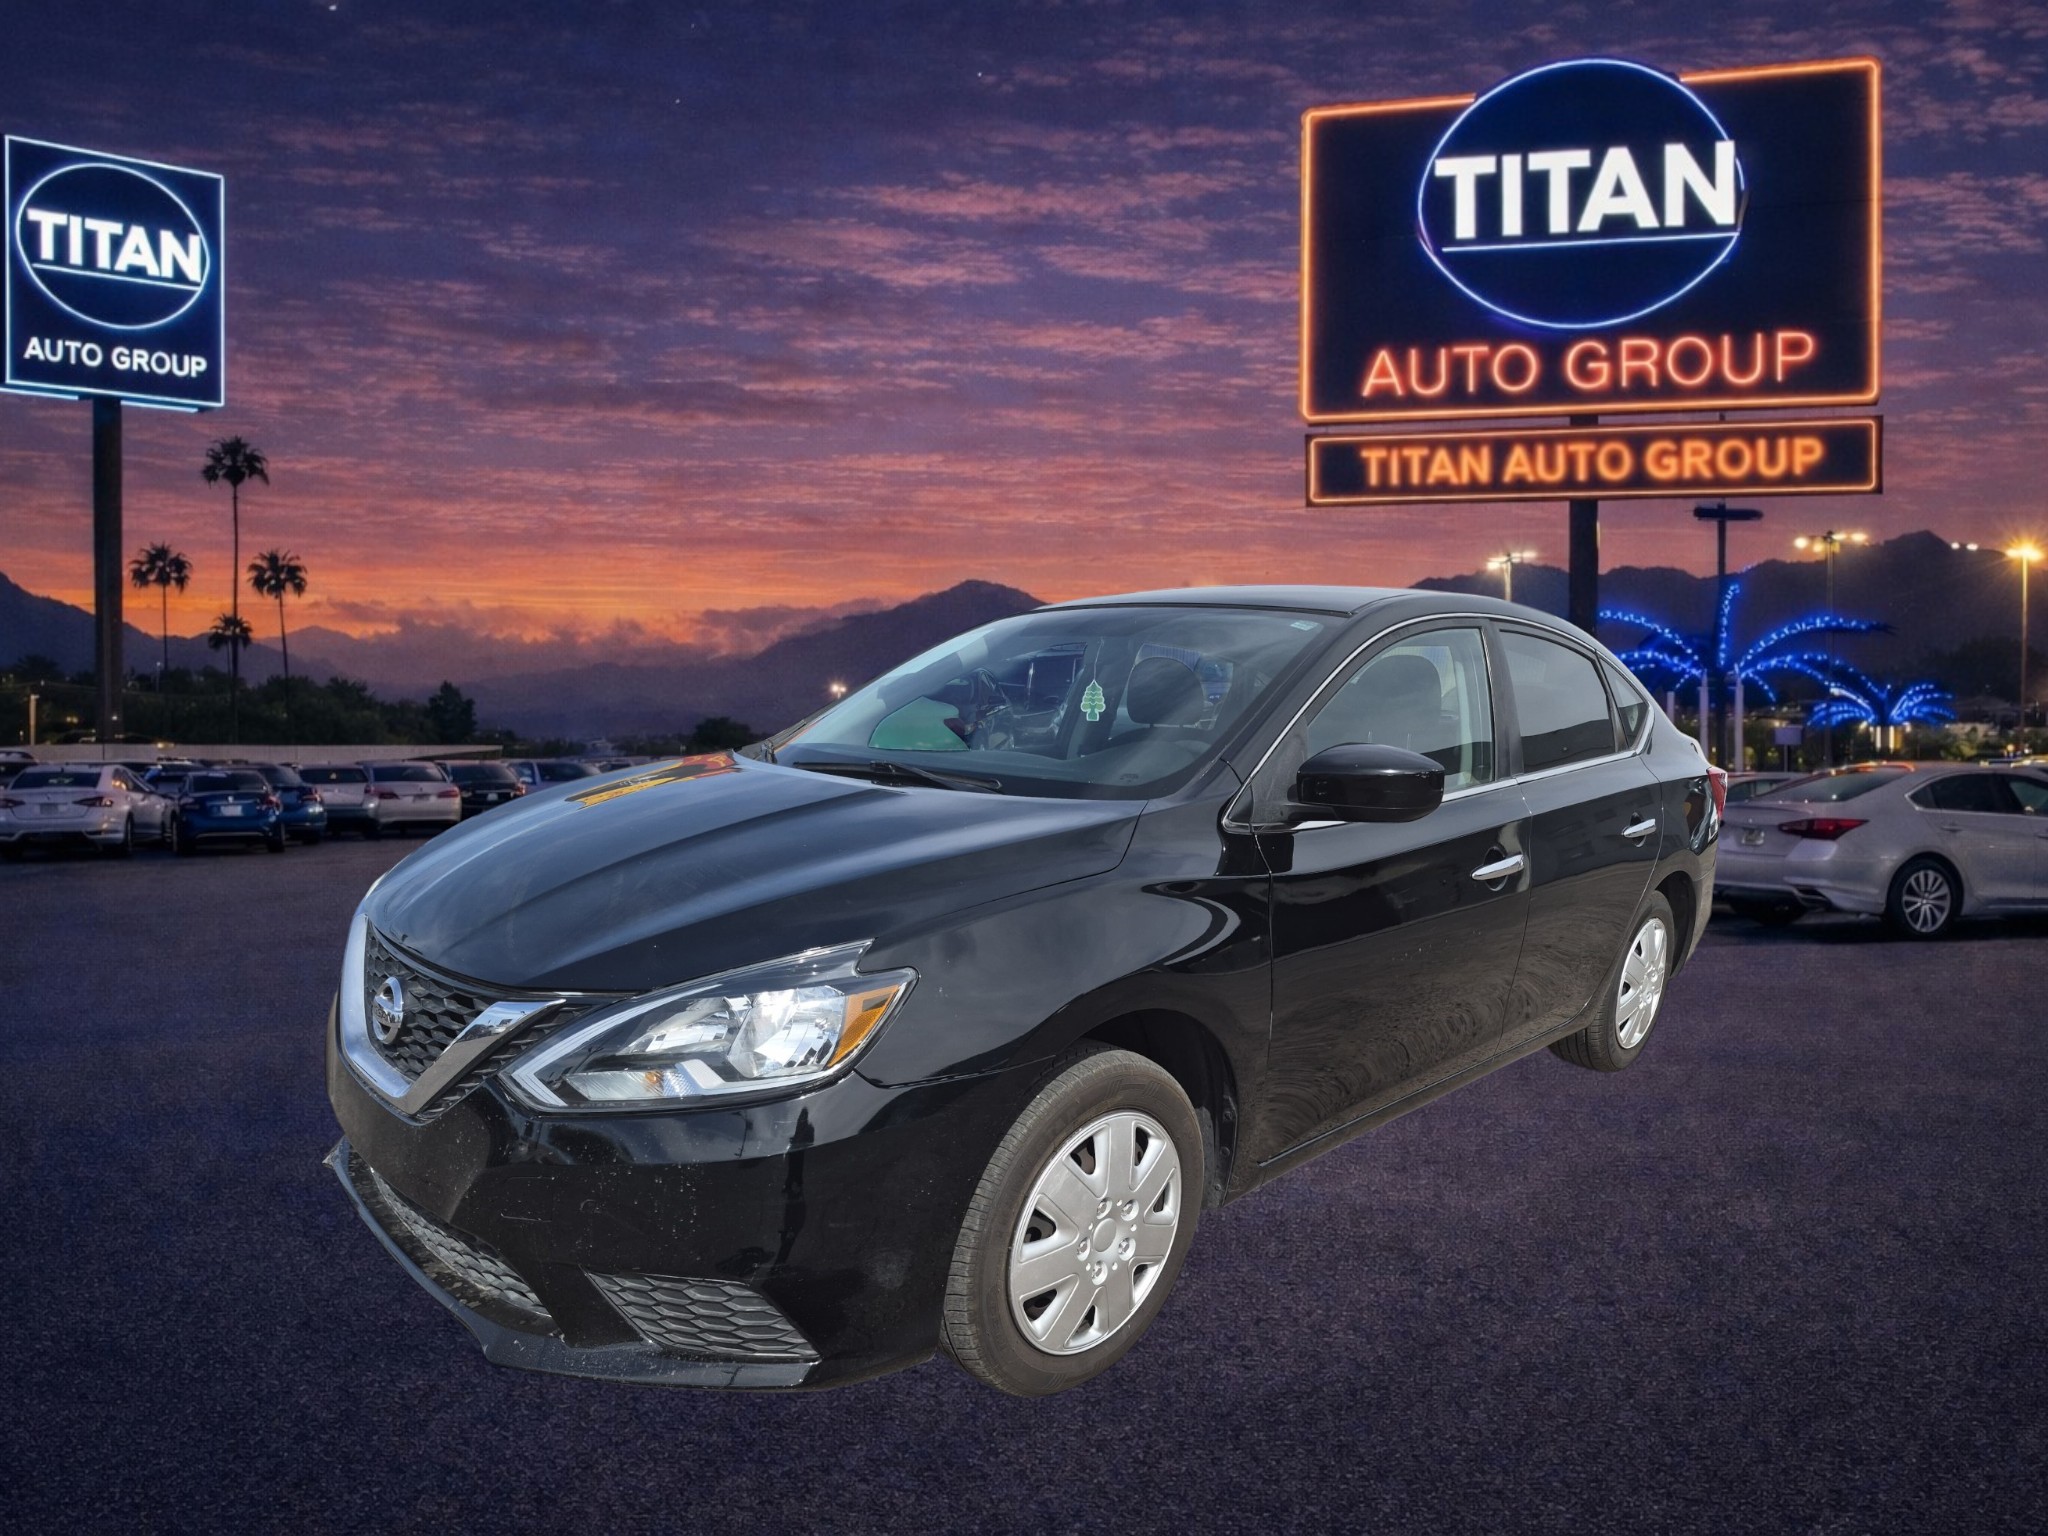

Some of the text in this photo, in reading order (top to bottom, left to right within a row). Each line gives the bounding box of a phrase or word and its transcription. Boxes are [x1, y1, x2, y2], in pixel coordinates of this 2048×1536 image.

[1435, 140, 1735, 239] TITAN
[26, 207, 201, 283] TITAN
[24, 336, 207, 377] AUTO GROUP
[1360, 330, 1814, 397] AUTO GROUP
[1361, 436, 1824, 486] TITAN AUTO GROUP
